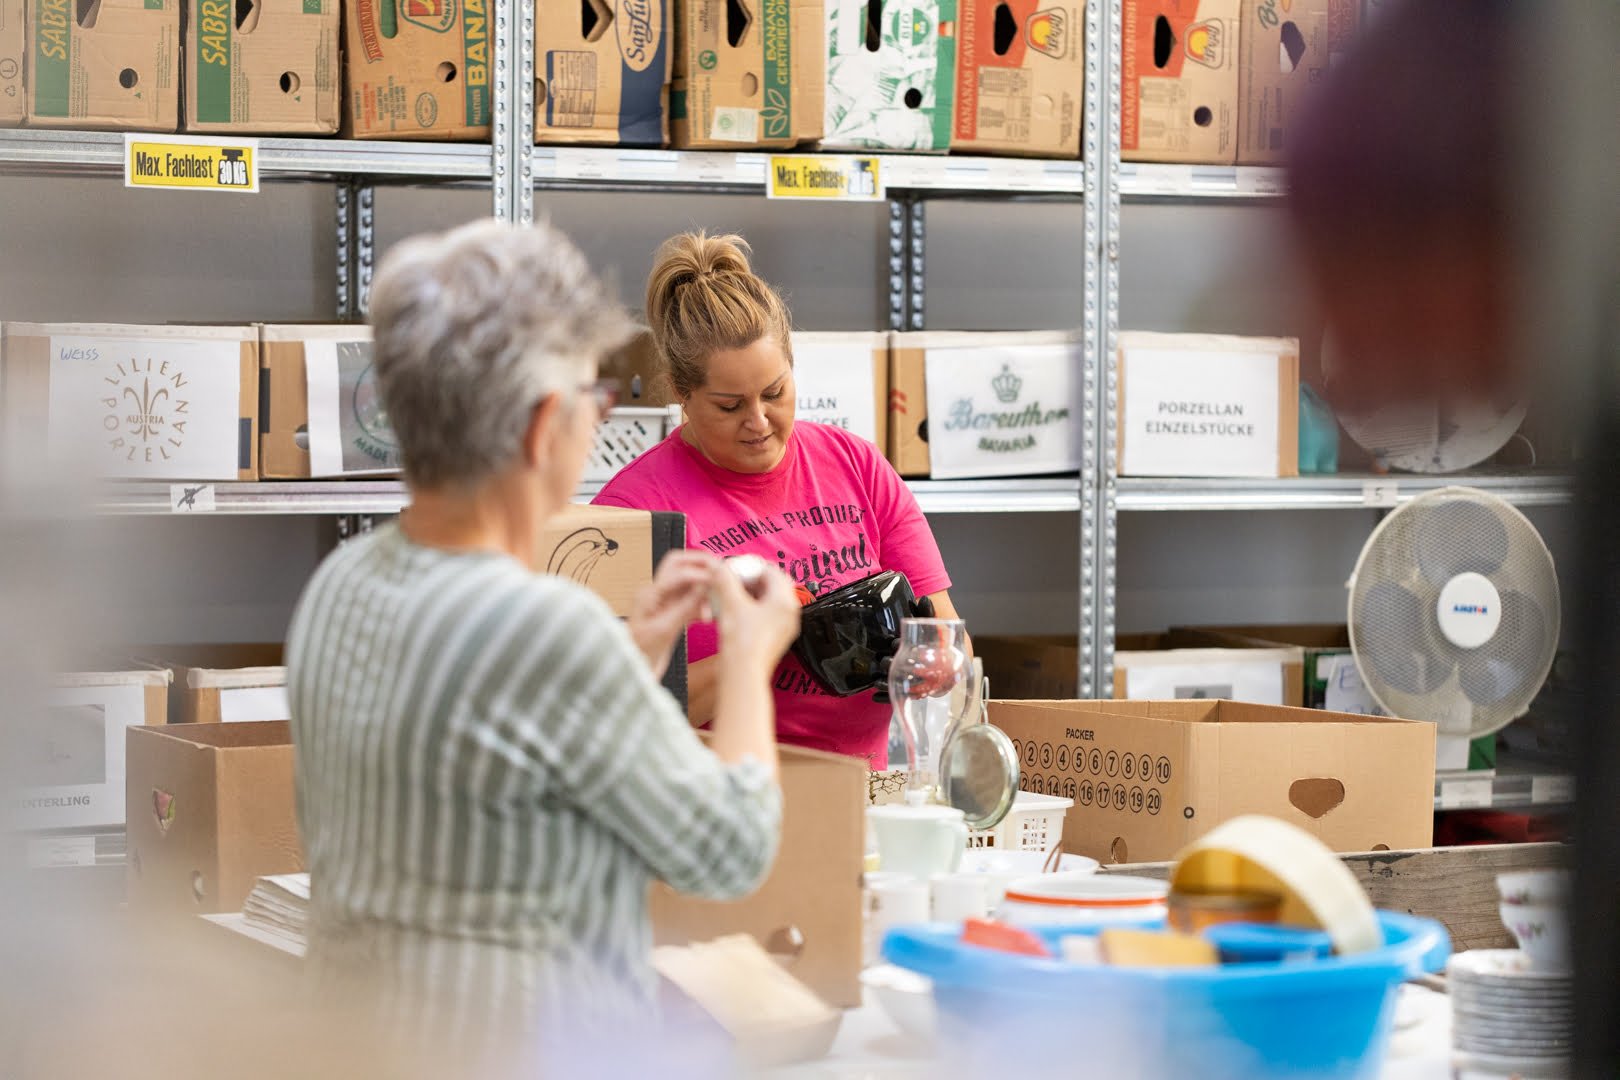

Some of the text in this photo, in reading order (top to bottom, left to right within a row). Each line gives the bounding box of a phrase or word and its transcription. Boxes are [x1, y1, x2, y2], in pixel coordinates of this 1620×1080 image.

[440, 0, 454, 27] BANA
[202, 0, 228, 65] SABR
[361, 12, 380, 57] PREMIUM
[624, 0, 653, 62] SanLu
[765, 0, 777, 61] BANAN
[776, 18, 788, 84] CERTIFIED
[962, 71, 975, 134] BANANAS
[1124, 82, 1136, 145] BANANAS
[136, 151, 214, 179] Max. Fachlast
[777, 165, 799, 188] Max.
[60, 347, 99, 361] WEISS
[105, 358, 187, 388] LILIEN
[126, 414, 165, 425] AUSTRIA
[1158, 401, 1244, 416] PORZELLAN
[1145, 418, 1255, 436] EINZELSTÜCKE
[353, 437, 388, 462] MADE
[700, 505, 866, 554] ORIGINAL PRODUCT
[1065, 727, 1095, 741] PACKER
